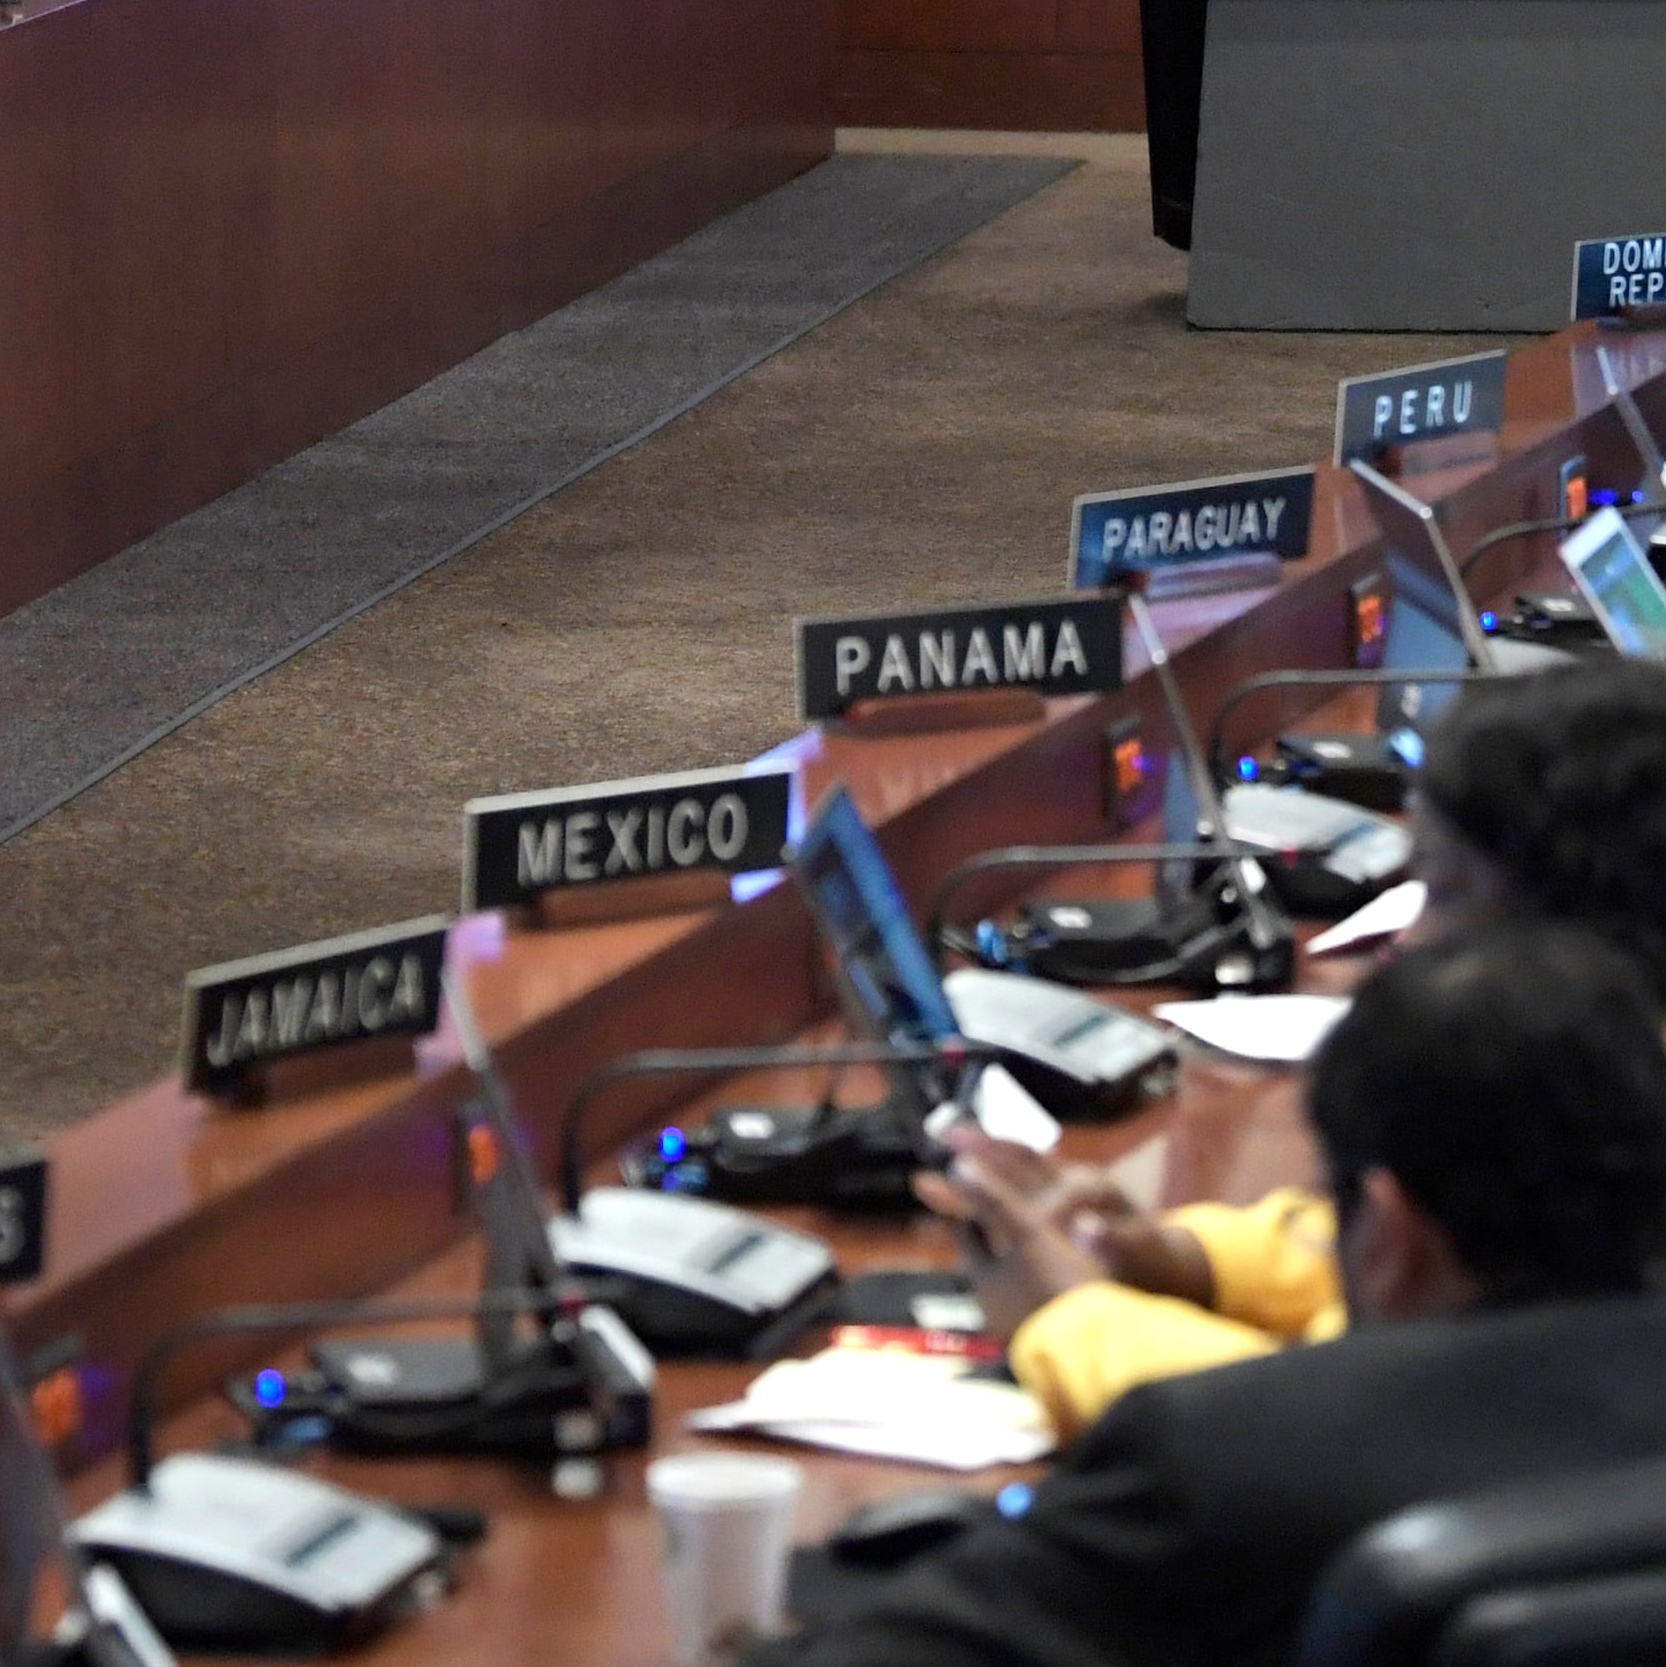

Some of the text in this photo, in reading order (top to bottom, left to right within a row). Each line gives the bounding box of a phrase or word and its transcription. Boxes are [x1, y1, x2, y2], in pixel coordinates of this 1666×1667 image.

[1374, 380, 1473, 439] PERU
[1102, 496, 1286, 563] PARAGUAY
[836, 620, 1088, 696] PANAMA
[517, 793, 749, 886] MEXICO
[207, 951, 427, 1068] JAMAICA
